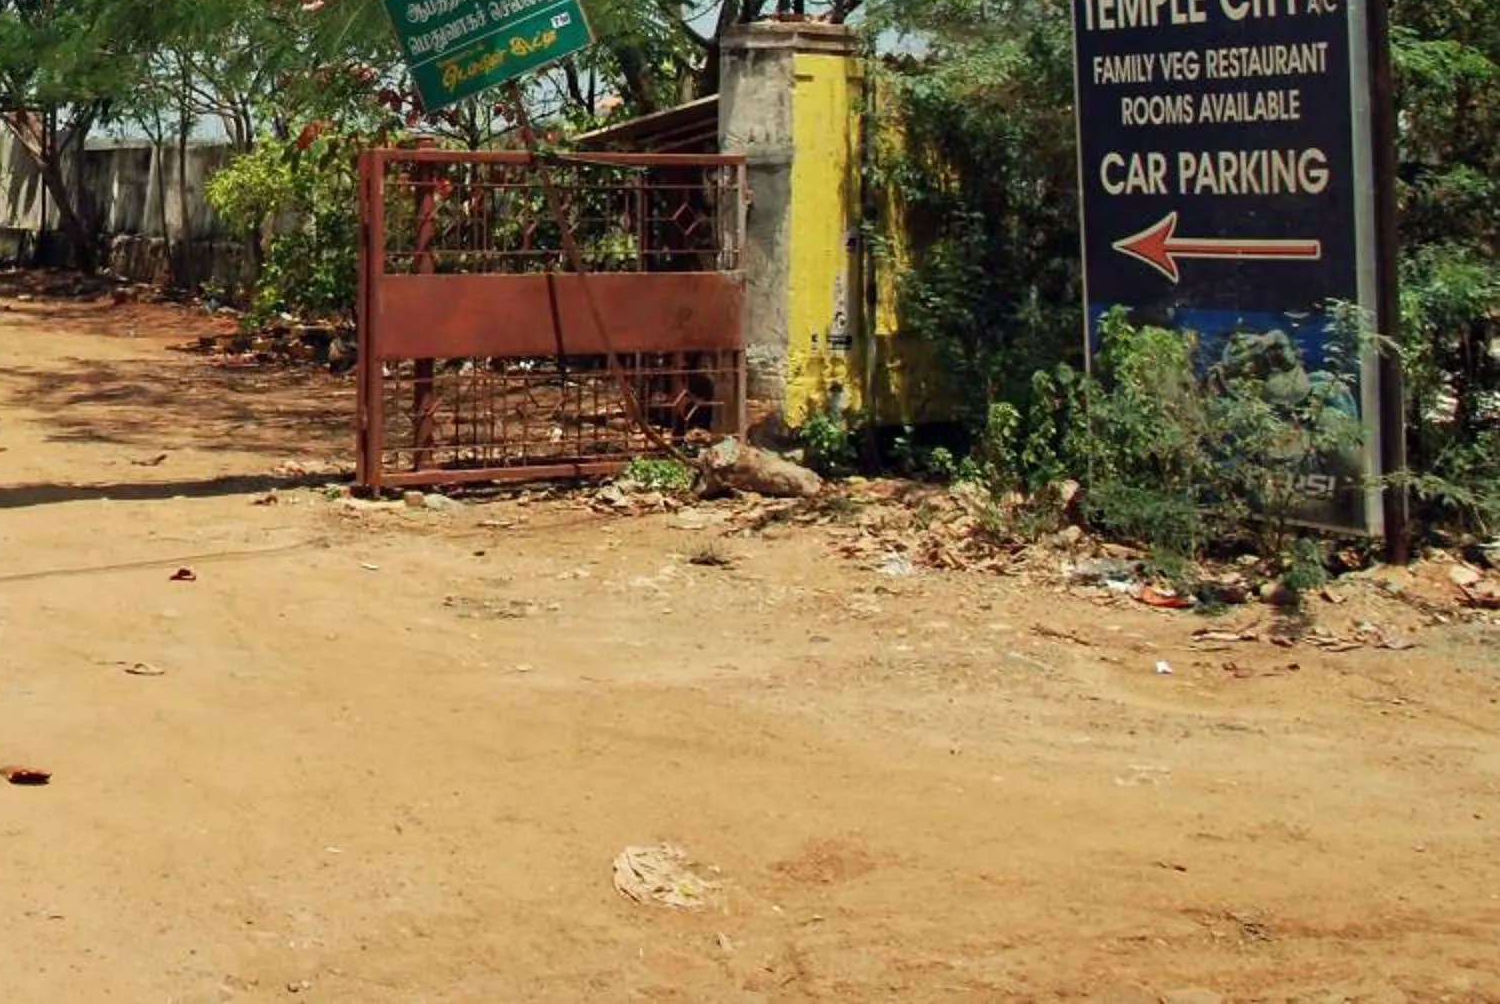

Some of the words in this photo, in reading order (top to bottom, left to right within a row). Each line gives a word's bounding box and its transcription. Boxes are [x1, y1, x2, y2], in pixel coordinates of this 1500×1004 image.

[1093, 51, 1154, 84] FAMILY
[1160, 49, 1200, 82] VEG
[1206, 41, 1329, 78] RESTAURANT
[1121, 93, 1194, 127] ROOMS
[1199, 88, 1301, 125] AVAILABLE
[1100, 151, 1168, 195] CAR
[1179, 147, 1330, 195] PARKING
